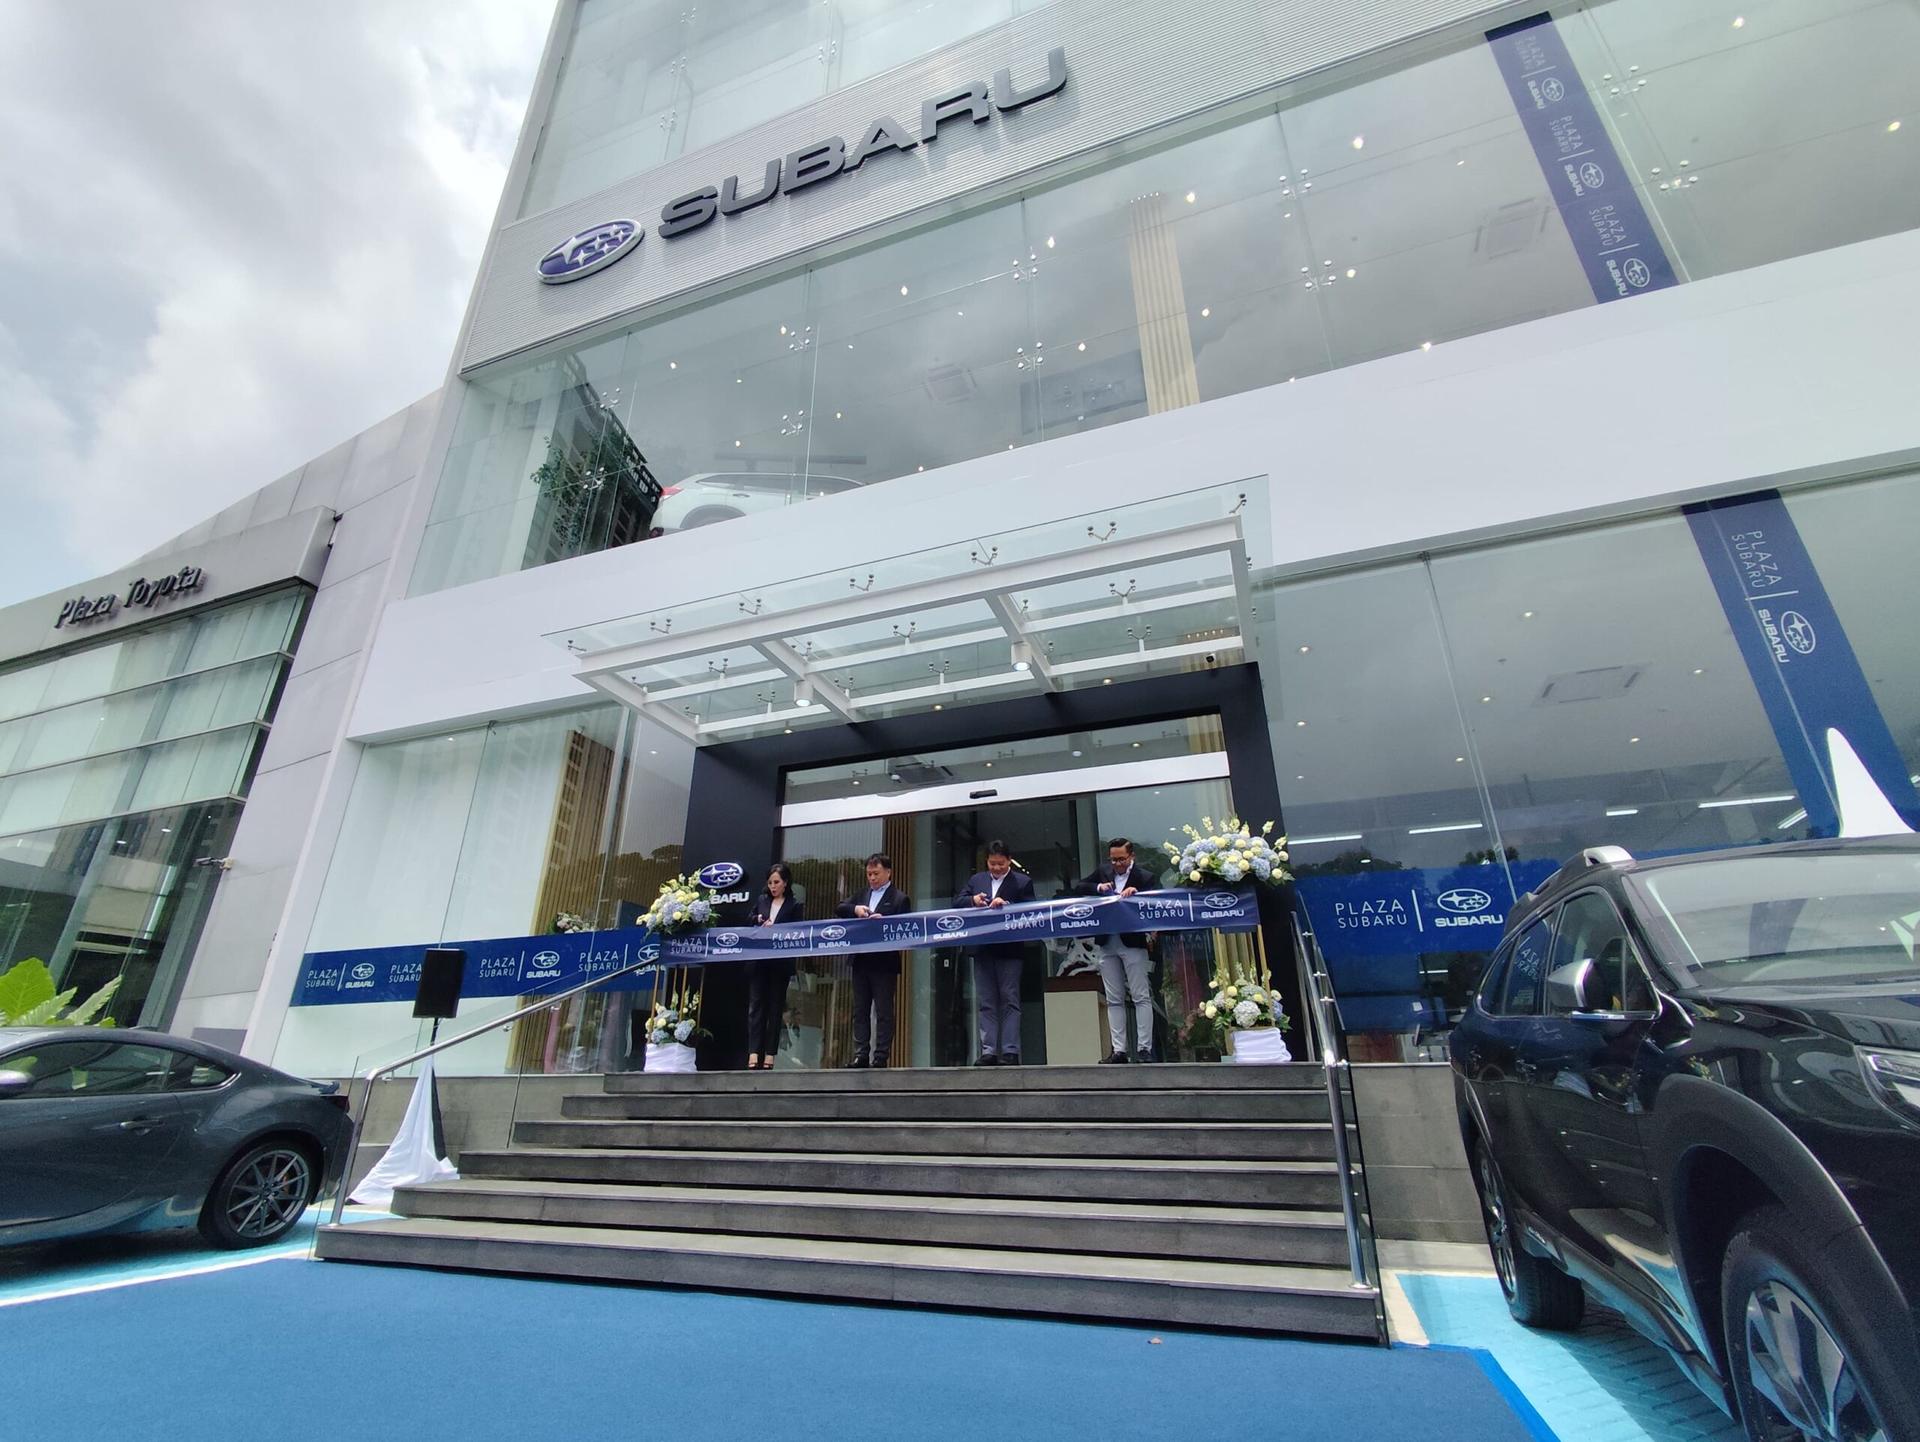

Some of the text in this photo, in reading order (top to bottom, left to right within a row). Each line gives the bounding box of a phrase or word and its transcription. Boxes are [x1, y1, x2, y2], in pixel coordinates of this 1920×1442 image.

[1528, 80, 1544, 110] SUBARU
[1550, 120, 1572, 153] SUBARU
[1560, 115, 1584, 150] PLAZA
[658, 46, 1068, 238] SUBARU
[1564, 164, 1584, 196] SUBARU
[1590, 208, 1613, 246] SUBARU
[1600, 204, 1626, 243] PLAZA
[1606, 259, 1629, 296] SUBARU
[1732, 534, 1765, 588] SUBARU
[1746, 530, 1782, 586] PLAZA
[54, 565, 202, 628] Plaza Toyota
[1758, 608, 1790, 663] SUBARU
[709, 892, 750, 904] BARU
[1138, 899, 1183, 910] PLAZA
[1335, 899, 1404, 916] PLAZA
[1004, 910, 1044, 922] PLAZA
[1139, 909, 1184, 920] SUBARU
[1201, 909, 1244, 919] SUBARU
[1004, 919, 1045, 930] SUBARU
[1060, 920, 1100, 929] SUBARU
[1338, 914, 1407, 929] SUBARU
[1435, 914, 1503, 928] SUBARU
[882, 922, 920, 932] PLAZA
[772, 932, 805, 941] PLAZA
[883, 931, 920, 941] SUBARU
[933, 931, 968, 940] SUBARU
[671, 937, 702, 946] PLAZA
[772, 940, 806, 949] SUBARU
[818, 940, 850, 948] SUBARU
[670, 944, 702, 954] SUBARU
[579, 951, 619, 962] PLAZA
[390, 963, 422, 973] PLAZA
[480, 958, 516, 968] PLAZA
[578, 962, 619, 972] SUBARU
[308, 969, 338, 979] PLAZA
[480, 967, 515, 978] SUBARU
[526, 970, 561, 978] SUBARU
[306, 978, 336, 988] SUBARU
[388, 974, 421, 983] SUBARU
[345, 981, 375, 989] SUBARU
